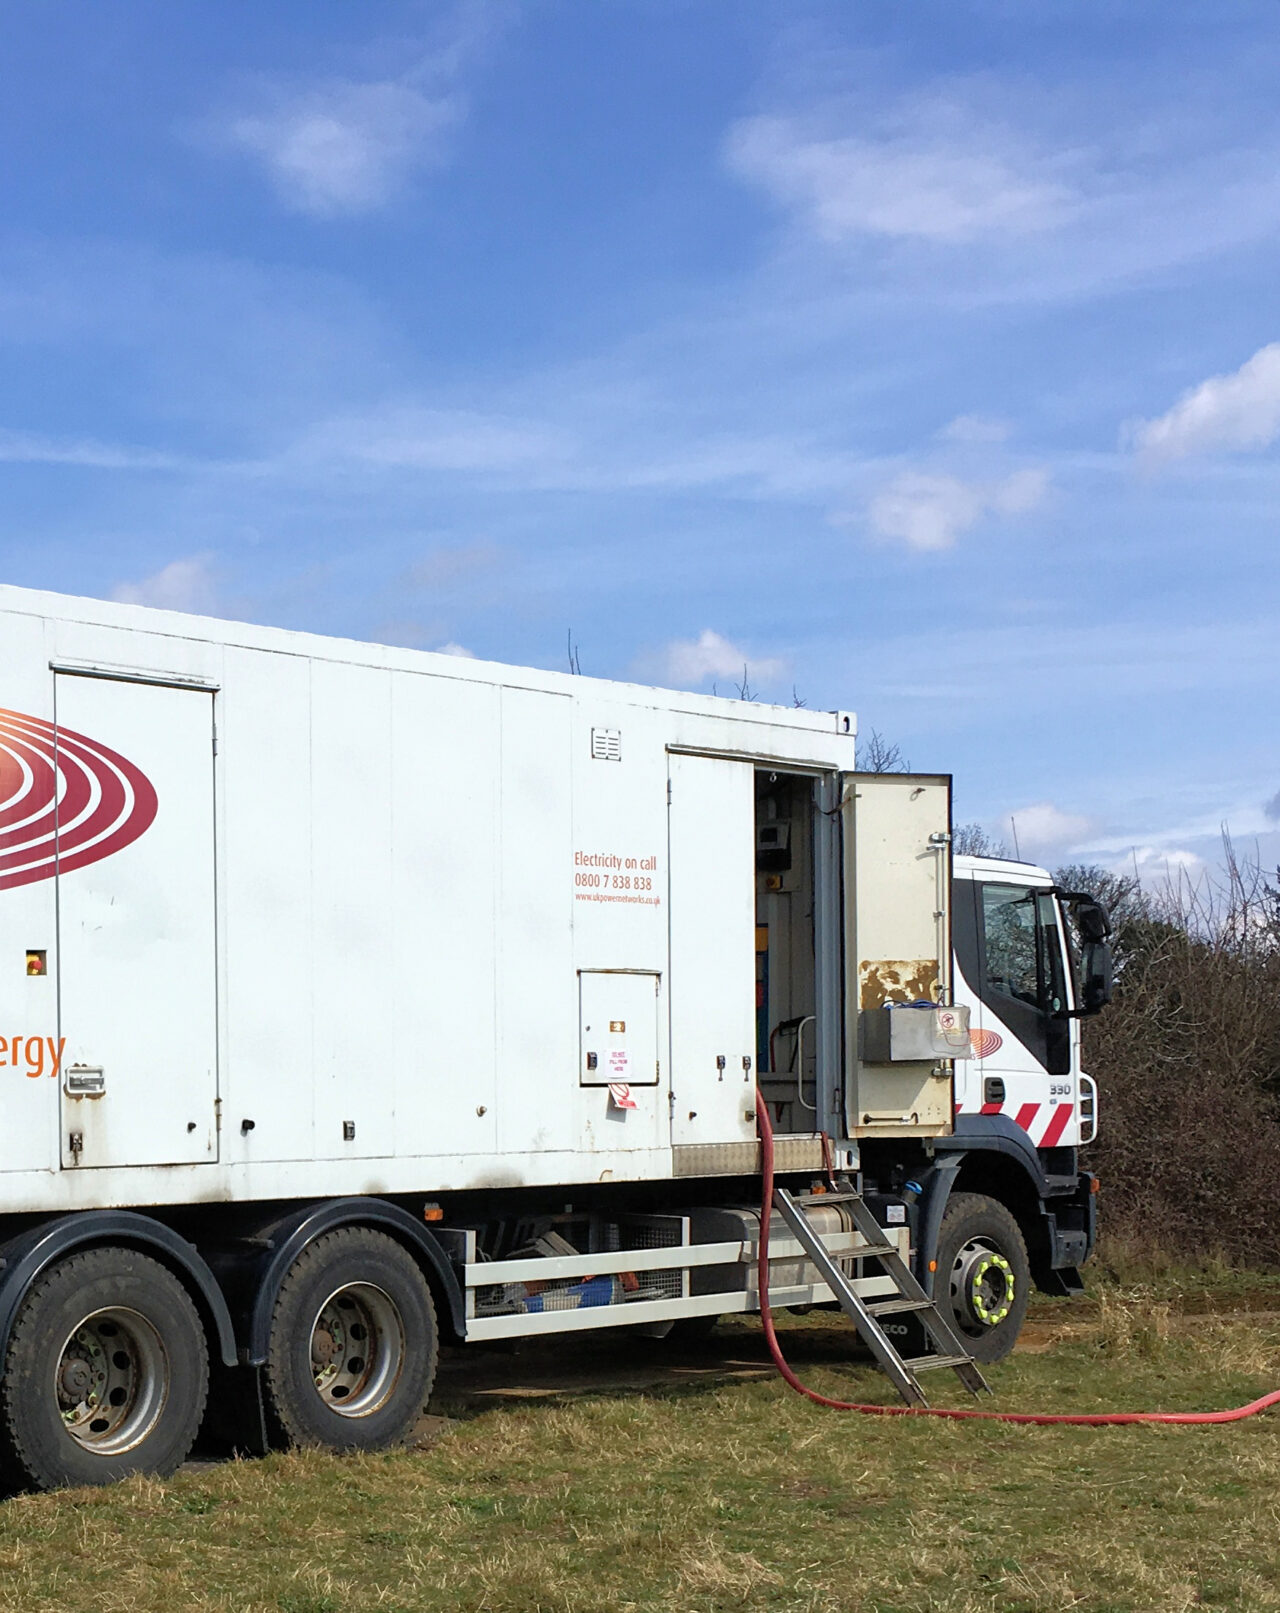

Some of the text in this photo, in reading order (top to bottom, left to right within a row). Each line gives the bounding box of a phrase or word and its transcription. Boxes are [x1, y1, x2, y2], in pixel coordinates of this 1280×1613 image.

[574, 851, 657, 871] Electricity on call
[574, 873, 652, 891] 0800 7 838 838
[1049, 1084, 1072, 1095] 330
